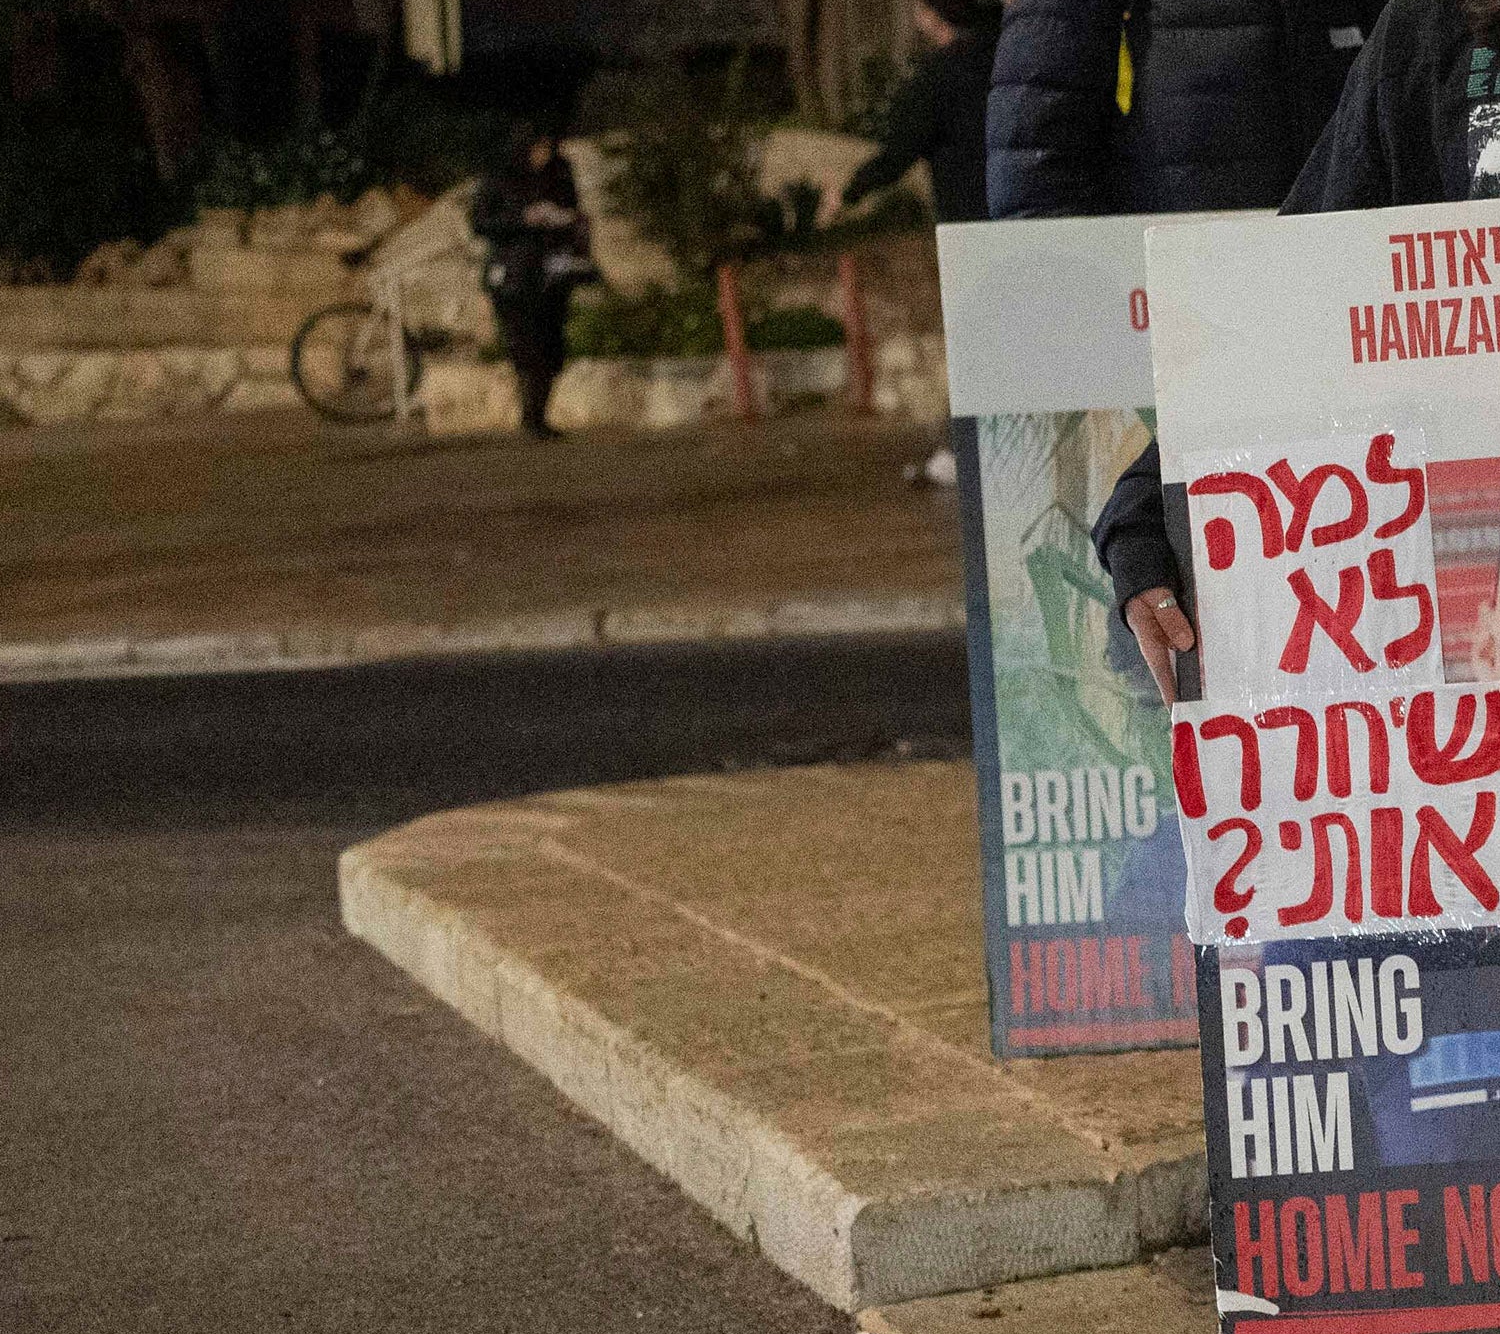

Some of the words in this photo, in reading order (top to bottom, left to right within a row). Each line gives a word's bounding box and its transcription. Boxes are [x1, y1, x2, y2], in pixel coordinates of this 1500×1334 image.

[1188, 433, 1425, 570] למה
[1279, 548, 1435, 673] לא
[1001, 765, 1157, 847] BRING
[1004, 849, 1104, 927] HIM
[1207, 792, 1499, 938] אותי?
[1009, 934, 1150, 1014] HOME
[1220, 954, 1424, 1067] BRING
[1227, 1072, 1354, 1179] HIM
[1234, 1190, 1425, 1299] HOME
